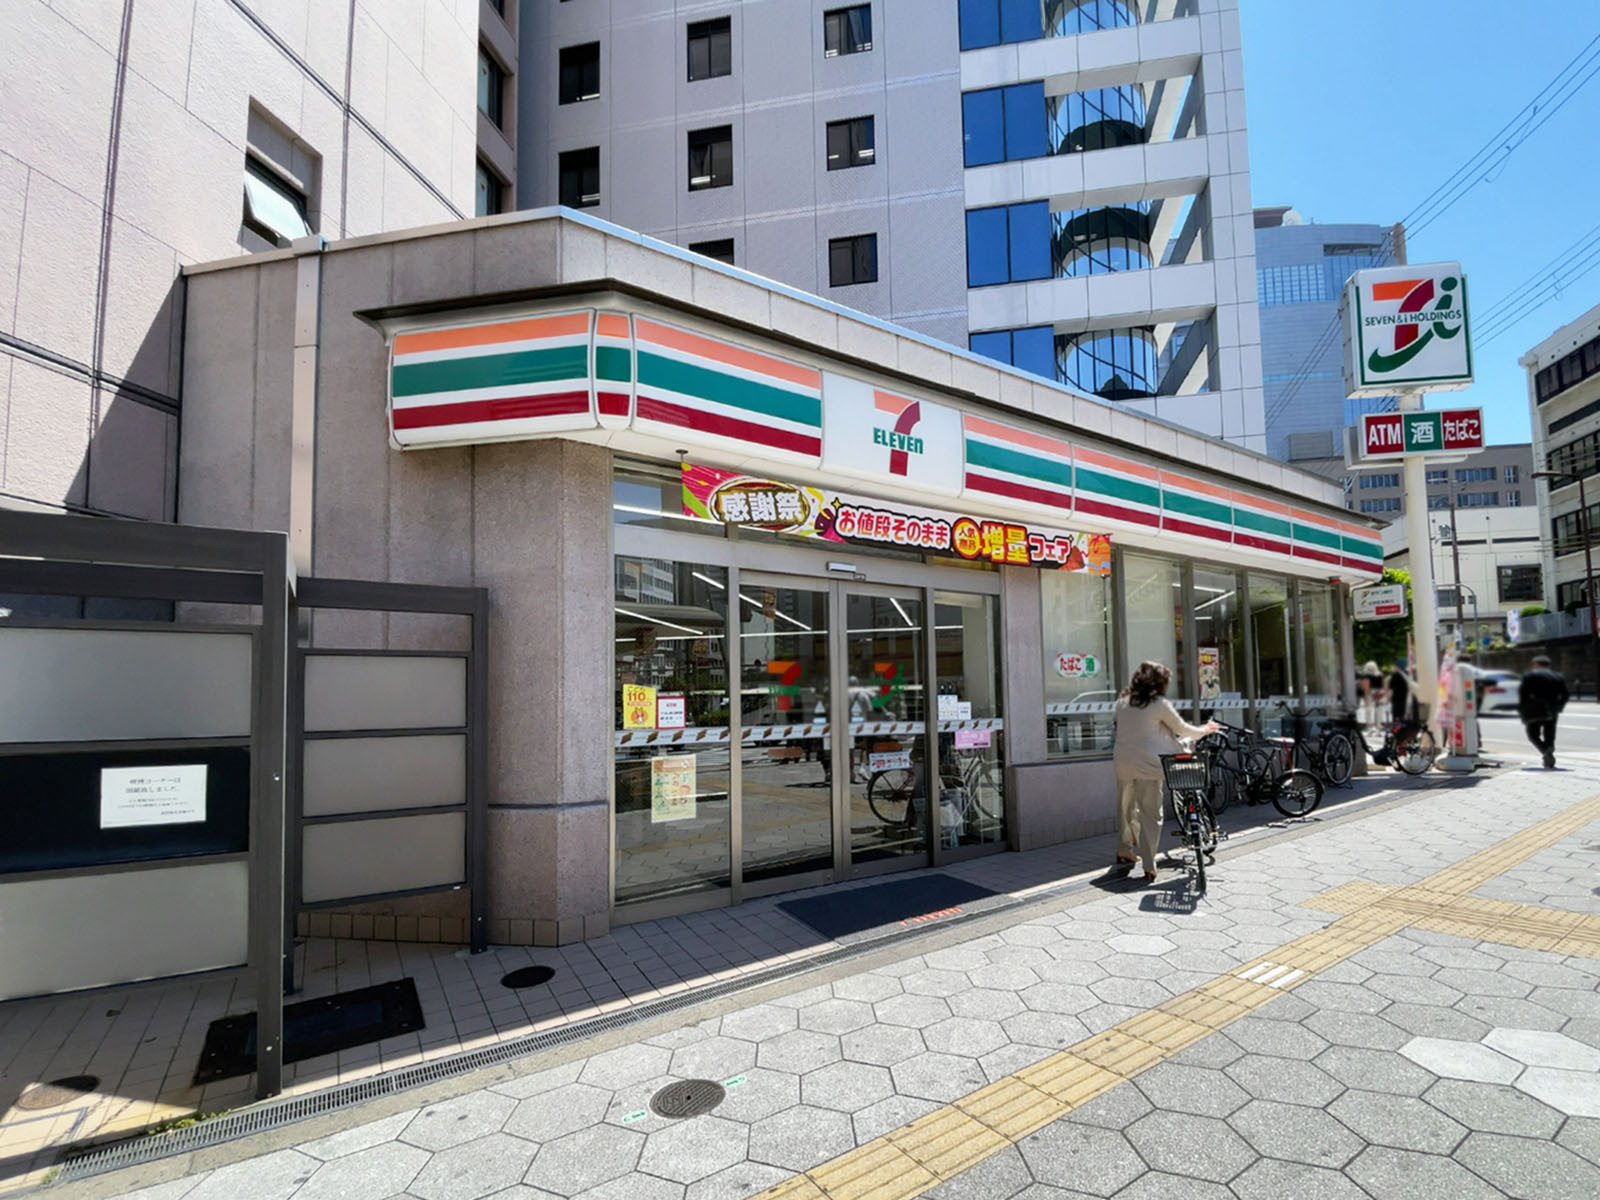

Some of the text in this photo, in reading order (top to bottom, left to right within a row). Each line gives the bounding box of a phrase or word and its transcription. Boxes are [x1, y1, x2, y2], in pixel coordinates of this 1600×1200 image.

[1410, 309, 1462, 322] HOLDINGS
[873, 427, 923, 454] ELEVEN
[1368, 423, 1402, 447] ATM
[1411, 421, 1435, 444] 酒
[1444, 418, 1481, 442] たばこ
[719, 491, 804, 522] 感謝祭
[837, 508, 1070, 564] お値段そのまま 増量 フェア
[958, 525, 977, 539] 人気
[959, 537, 977, 550] 商品
[1059, 656, 1082, 672] たばこ
[627, 692, 646, 702] 110
